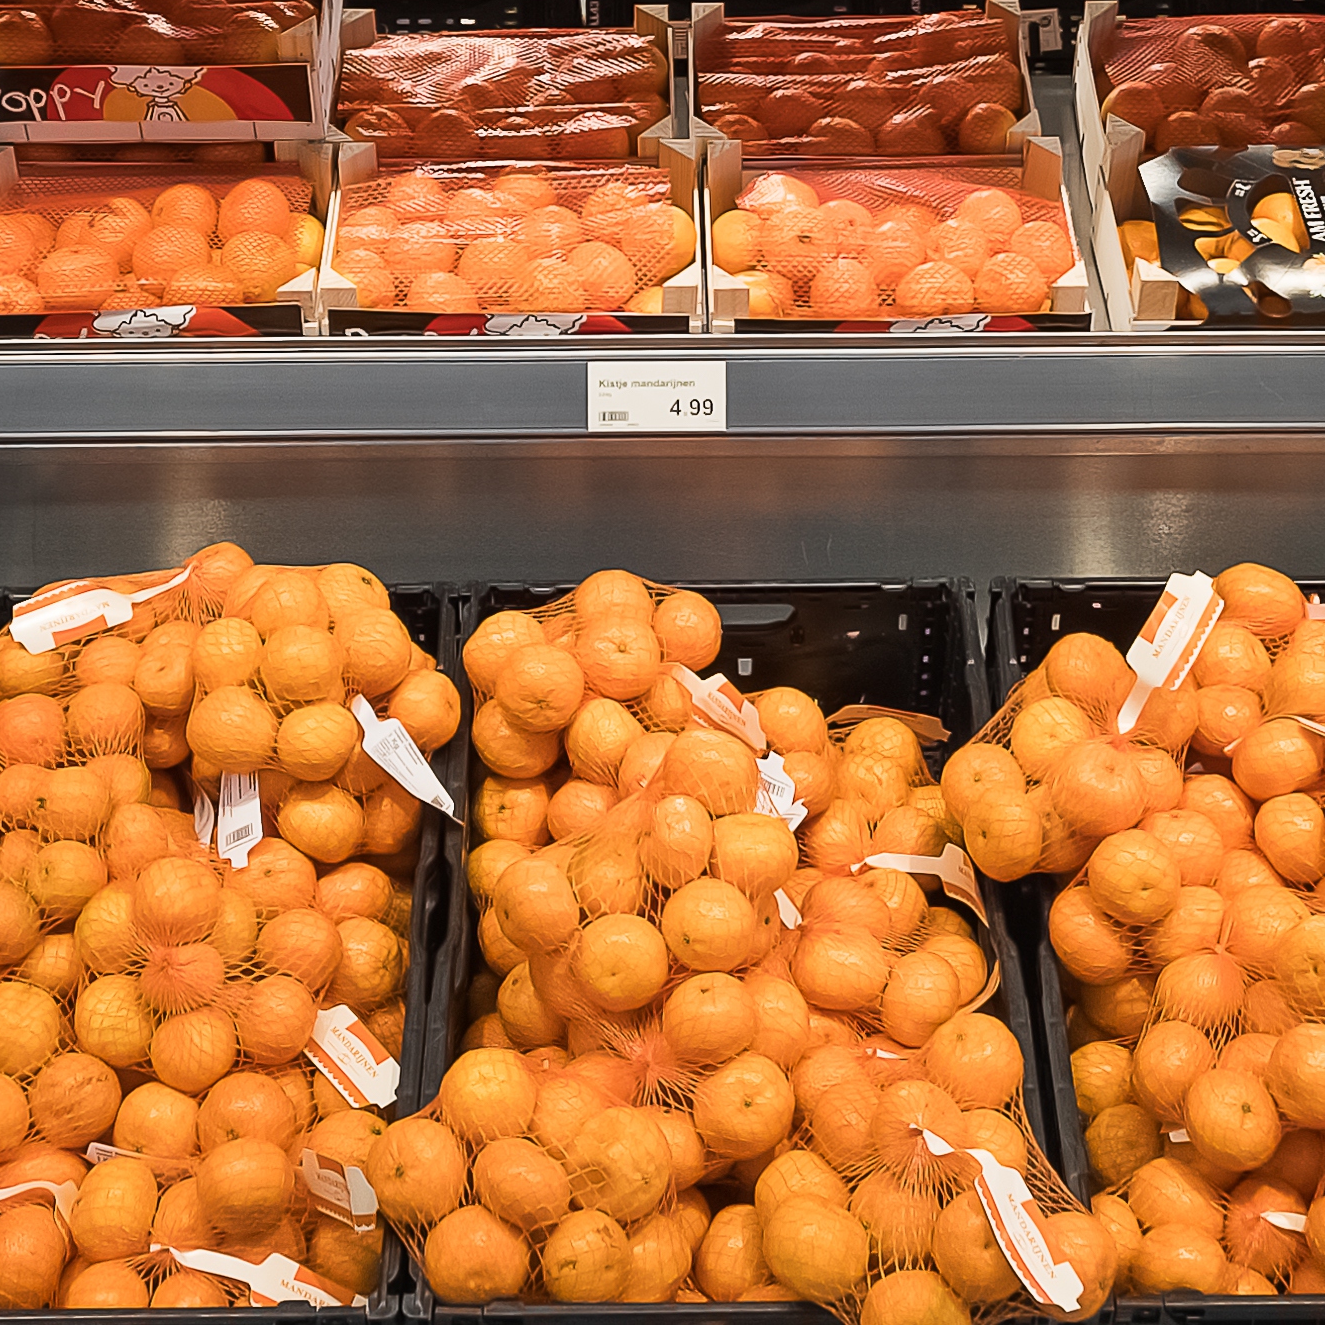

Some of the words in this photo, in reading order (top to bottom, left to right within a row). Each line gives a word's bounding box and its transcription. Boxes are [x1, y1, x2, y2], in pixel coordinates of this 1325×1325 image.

[599, 379, 628, 390] Kistje
[631, 379, 696, 389] mandarijnen
[669, 398, 714, 417] 4.99
[1152, 596, 1191, 659] MANDARIJNEN
[330, 1026, 378, 1078] MANDARIJNEN
[1007, 1193, 1056, 1279] MANDARIJNEN
[280, 1279, 329, 1306] MANDAR
